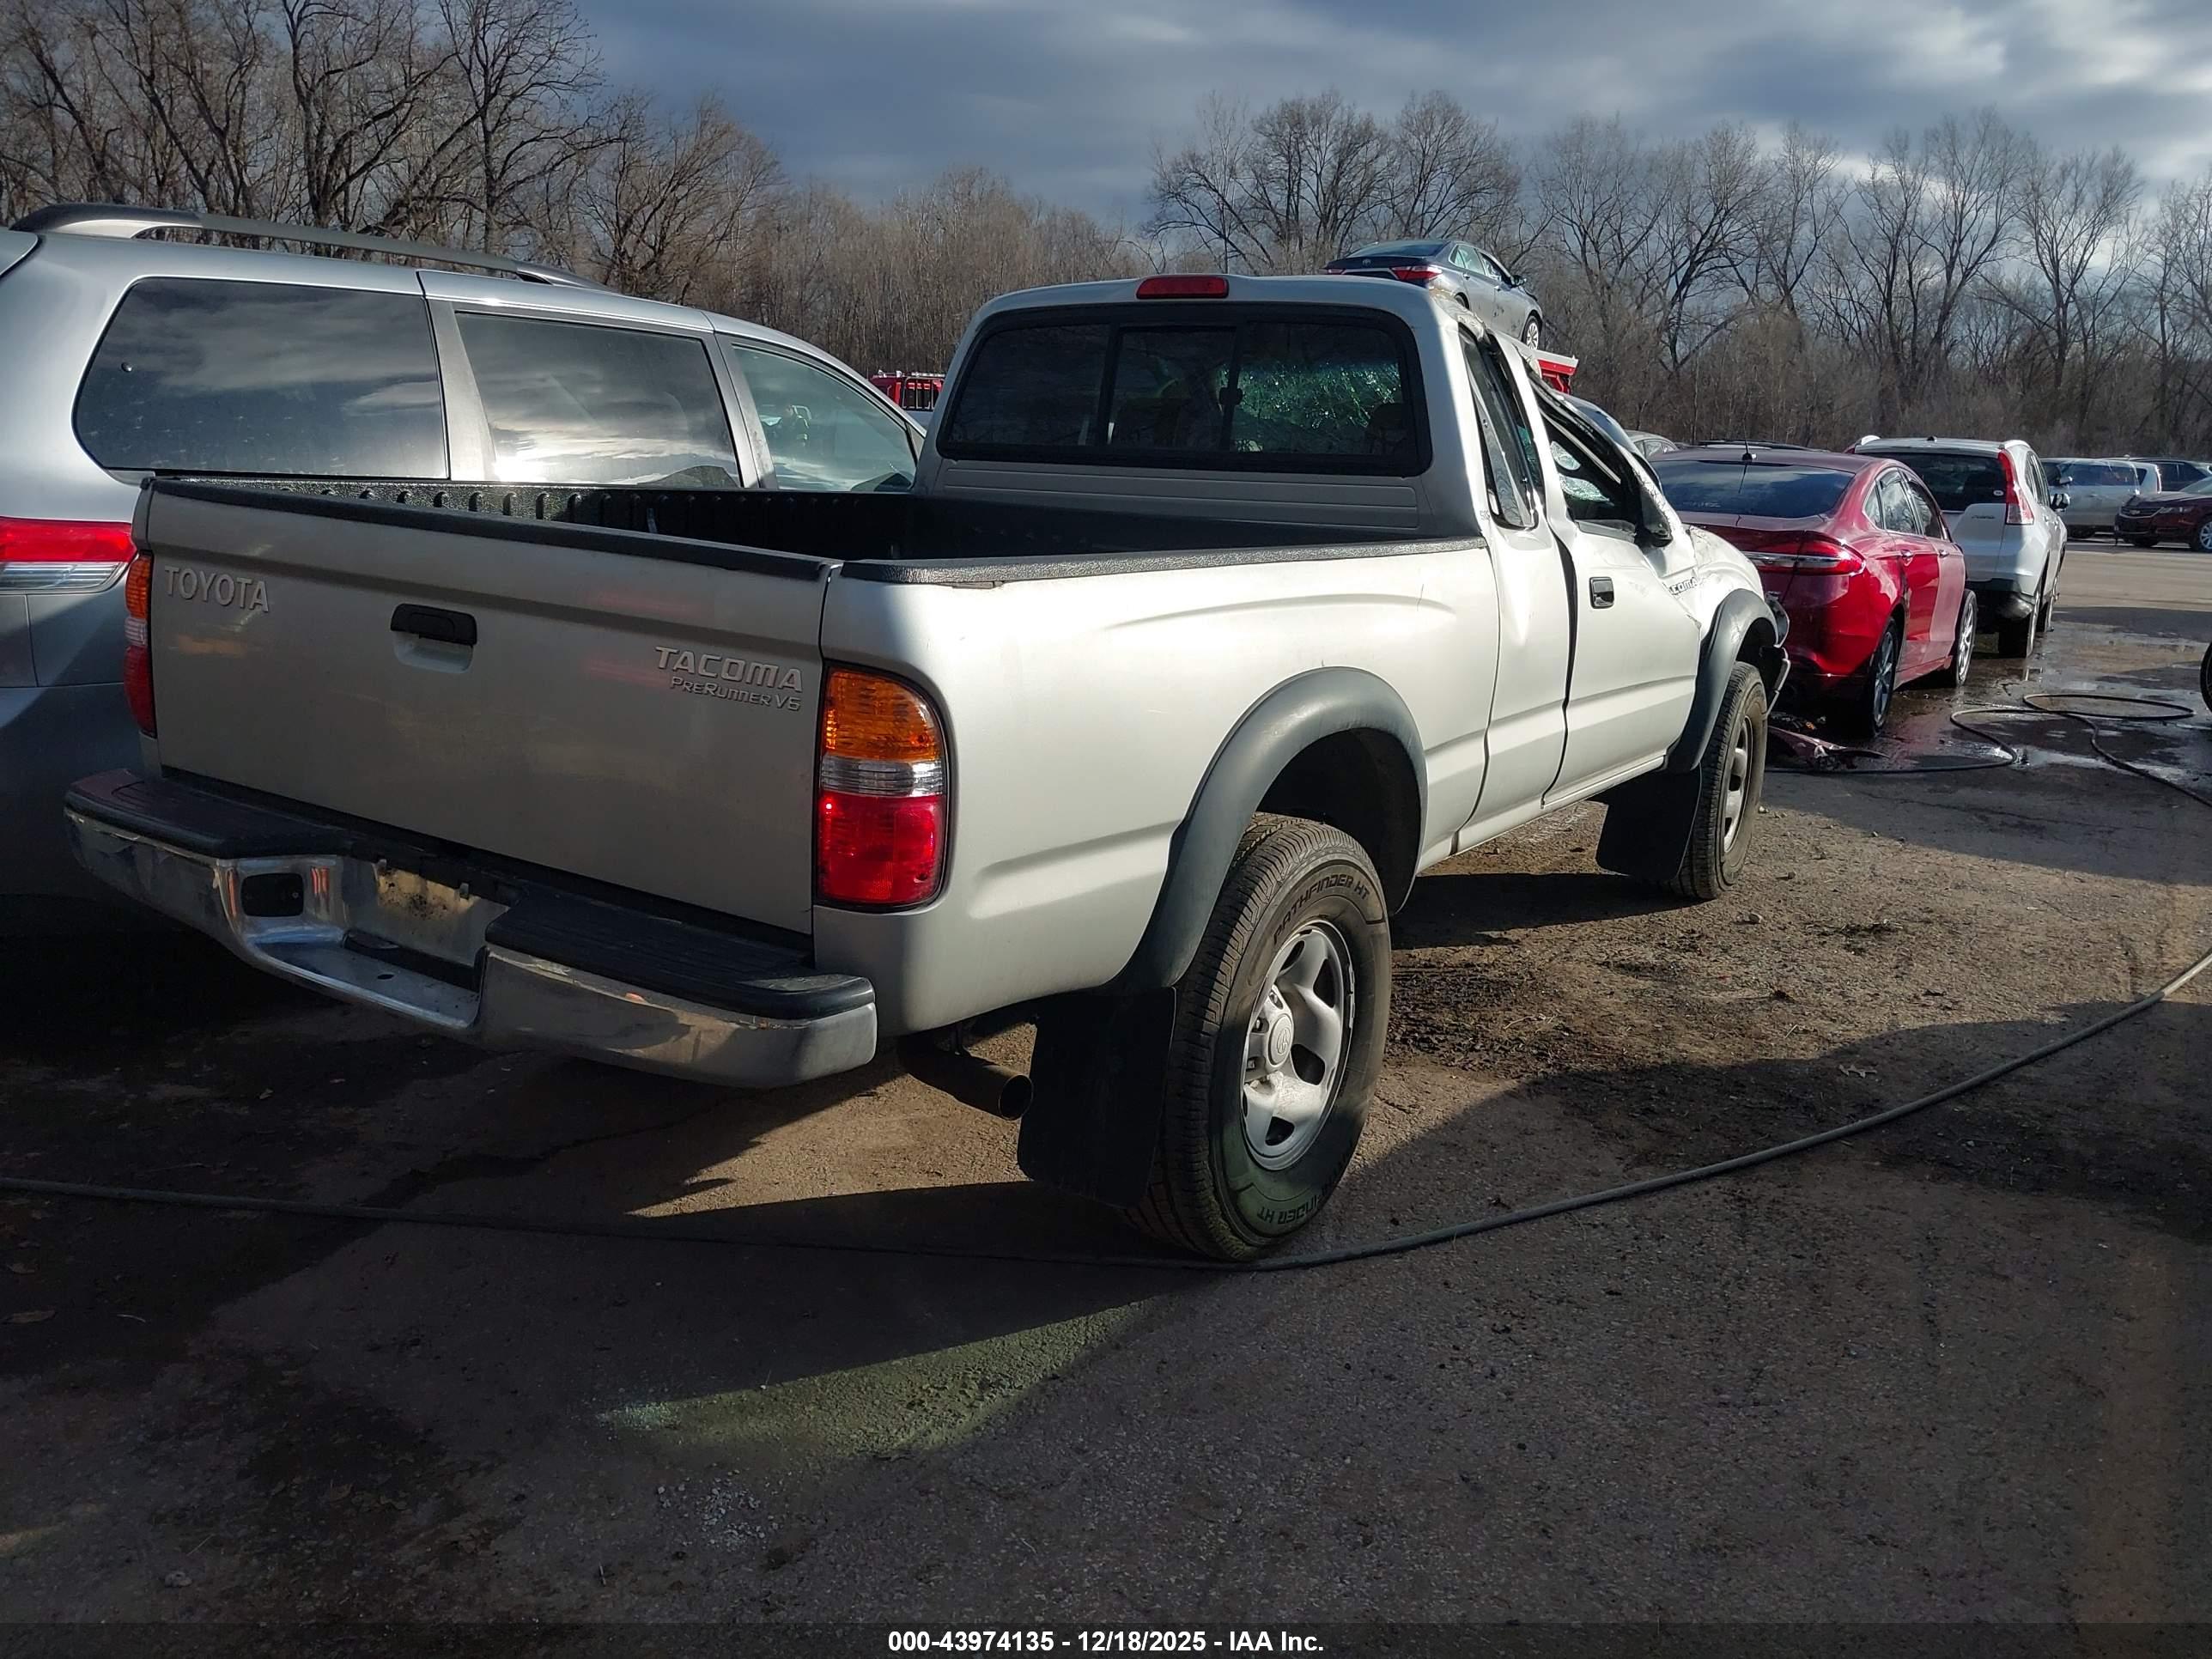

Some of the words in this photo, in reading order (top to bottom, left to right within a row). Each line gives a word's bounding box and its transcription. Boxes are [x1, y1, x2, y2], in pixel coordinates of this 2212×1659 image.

[164, 565, 269, 613] TOYOTA
[655, 646, 804, 693] TACOMA
[775, 694, 802, 711] V6
[1273, 873, 1354, 945] PATHFINDER
[1354, 880, 1371, 900] HT
